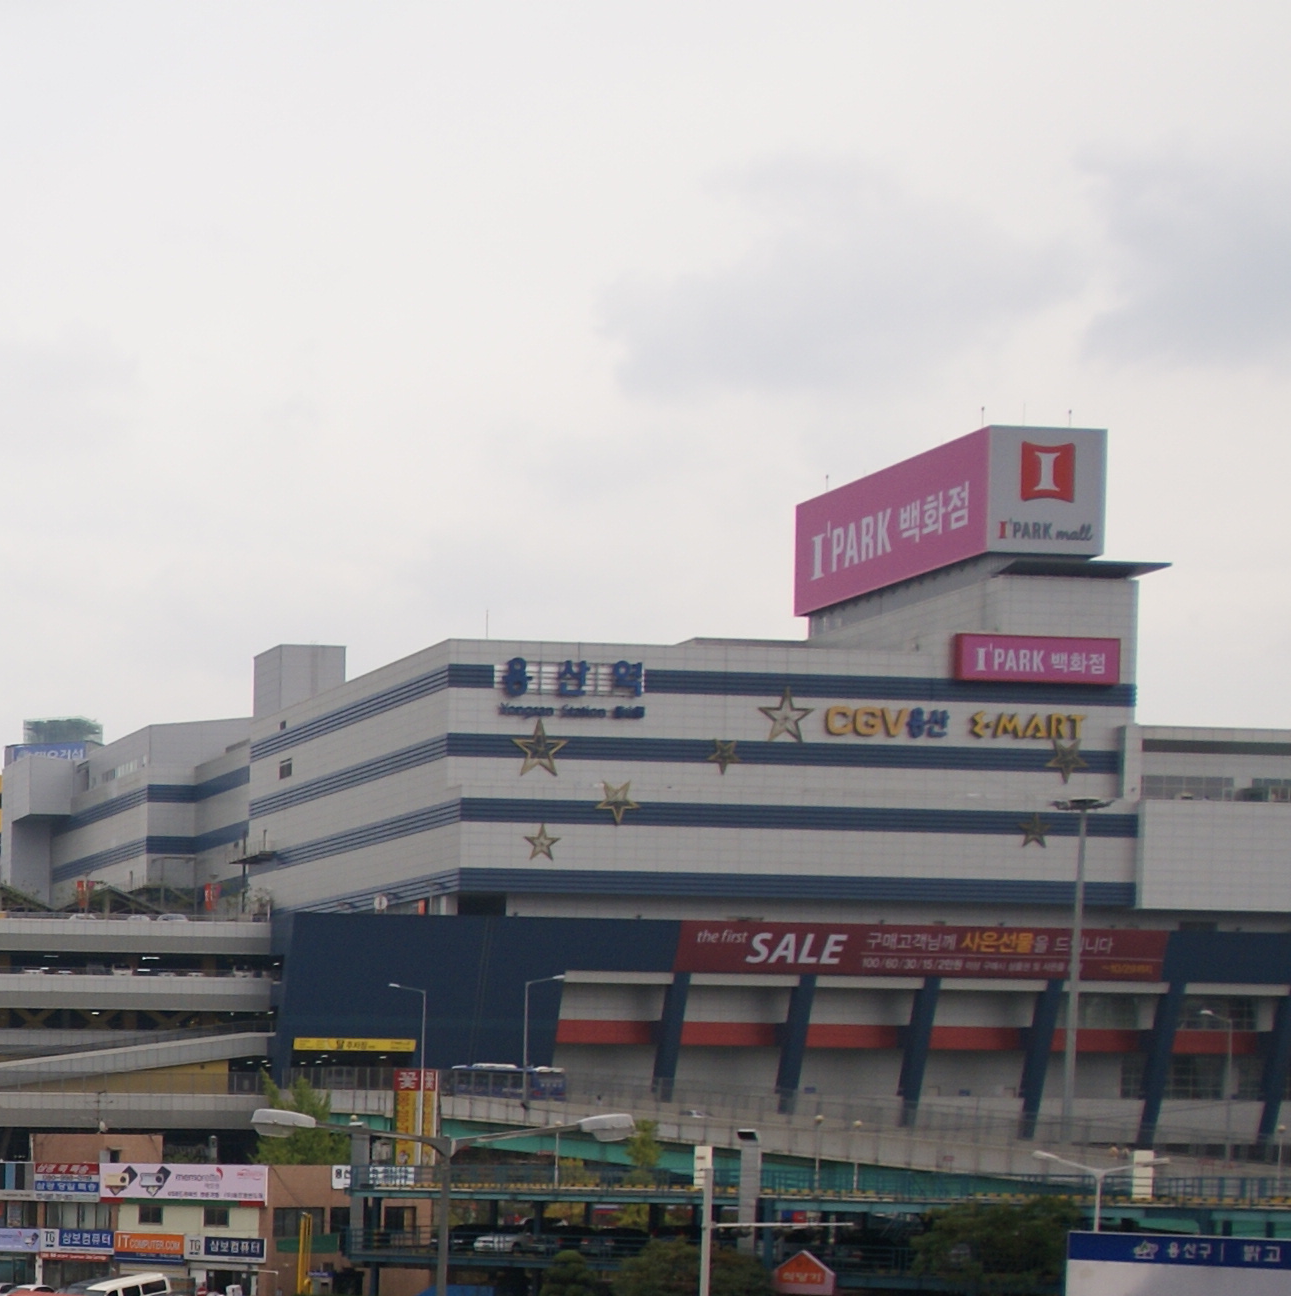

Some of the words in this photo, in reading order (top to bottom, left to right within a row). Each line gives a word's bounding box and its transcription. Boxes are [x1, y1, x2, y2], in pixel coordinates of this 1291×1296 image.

[899, 481, 971, 543] 백화점
[1055, 523, 1094, 543] mall
[1051, 651, 1107, 676] 백화점
[502, 657, 642, 697] 용산역
[499, 702, 554, 720] Yongsan
[560, 704, 606, 718] Station
[697, 929, 718, 945] the
[720, 929, 748, 946] first
[746, 932, 849, 965] SALE
[866, 931, 957, 953] 구매고객님께
[1054, 935, 1114, 956] 드니다
[61, 1230, 113, 1247] 삼보컴퓨터
[210, 1240, 260, 1254] 삼보컴퓨터
[1243, 1244, 1282, 1263] 밝고
